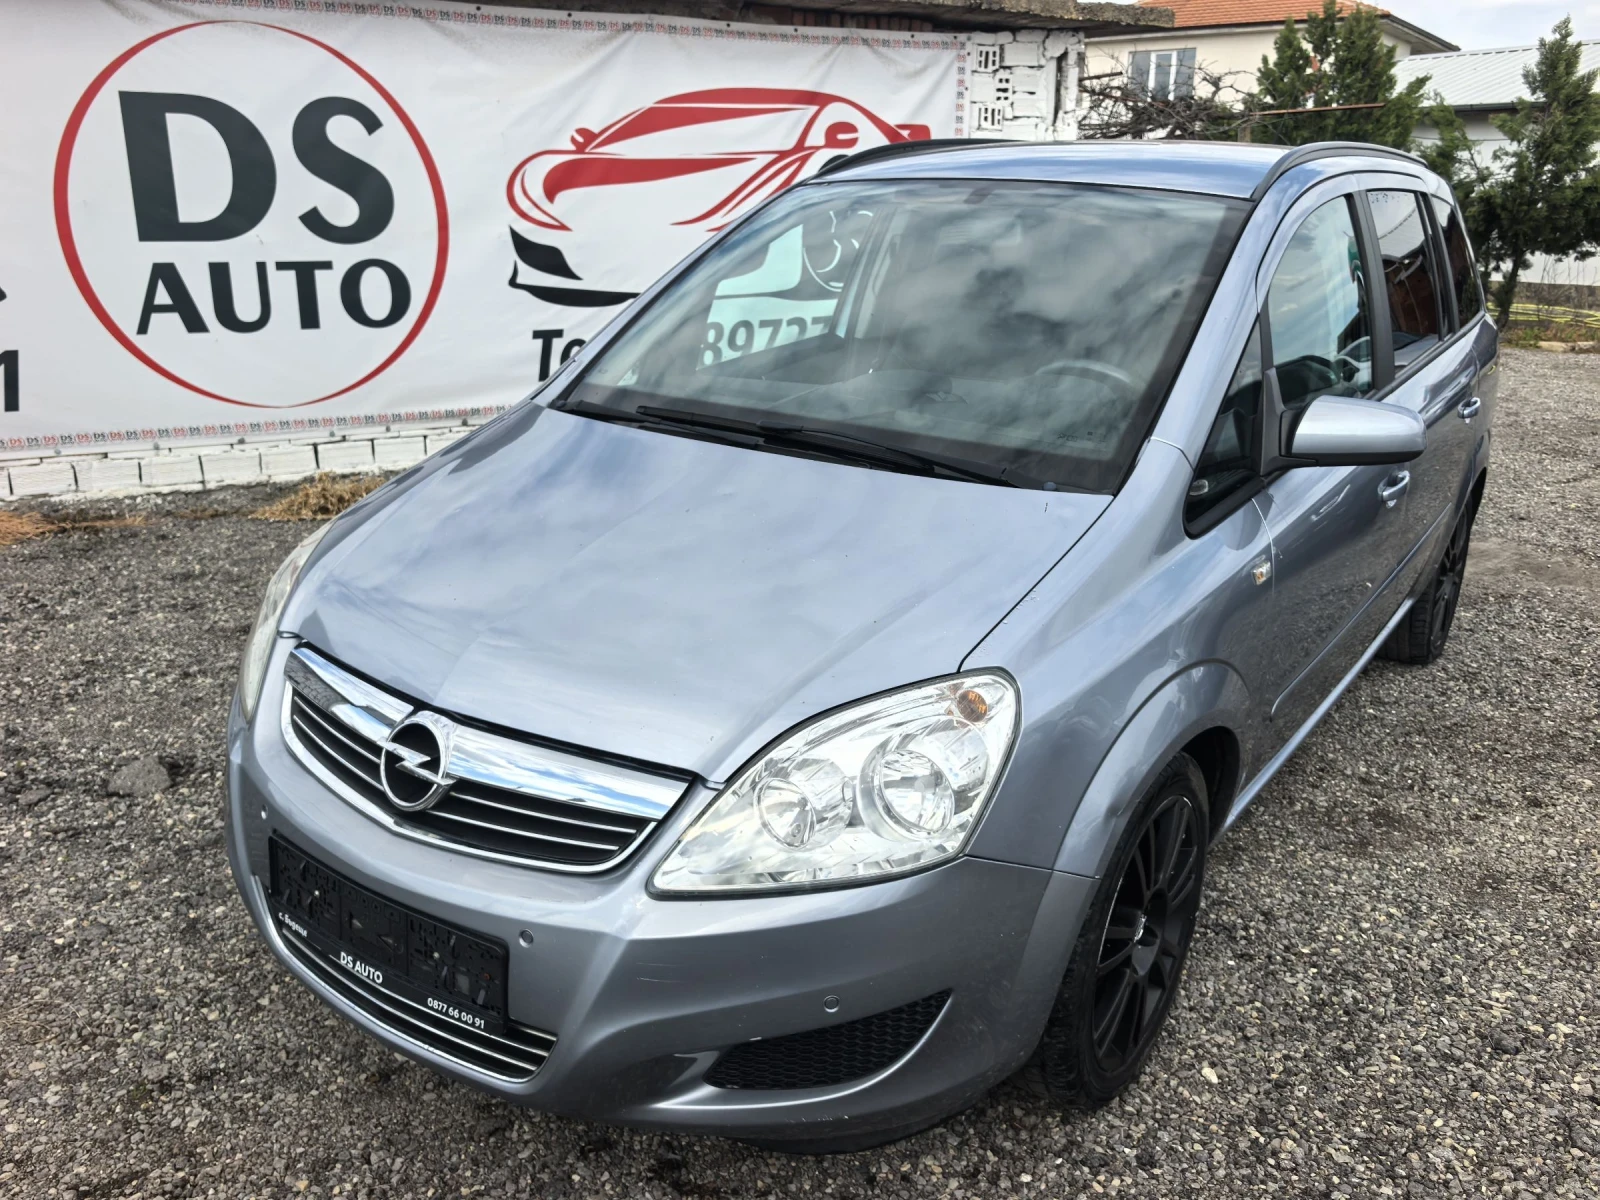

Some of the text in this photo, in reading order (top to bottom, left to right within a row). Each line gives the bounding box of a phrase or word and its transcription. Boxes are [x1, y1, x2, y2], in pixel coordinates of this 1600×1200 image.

[118, 91, 394, 245] DS
[136, 258, 412, 336] AUTO
[340, 951, 383, 984] DS AUTO
[427, 997, 485, 1029] 0877 66 00 91
